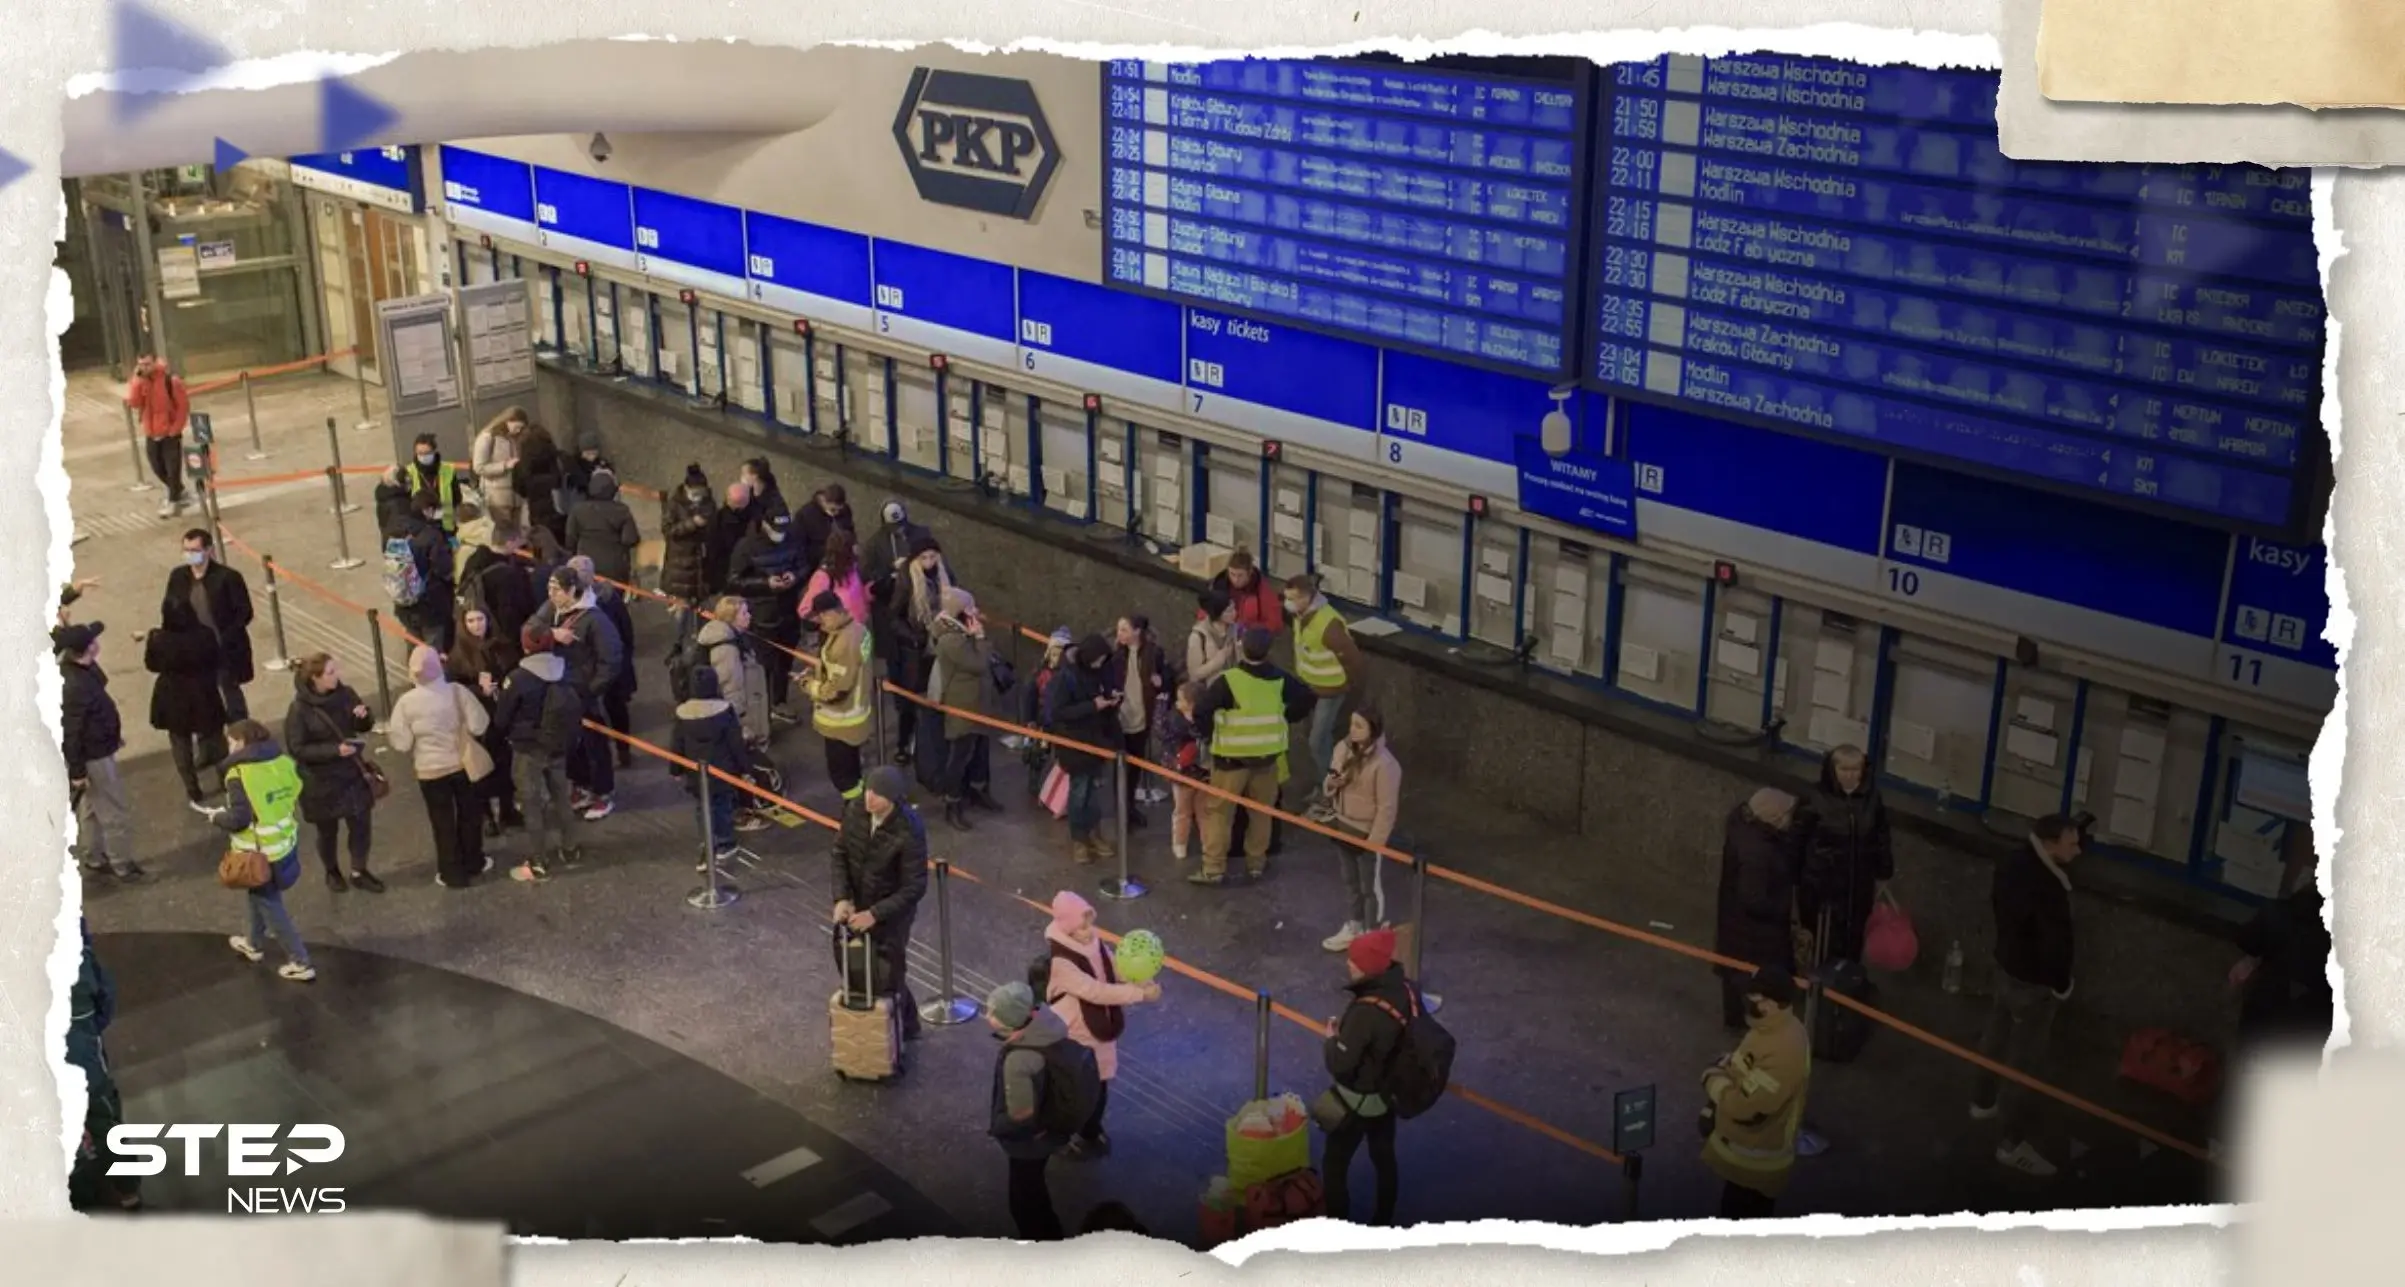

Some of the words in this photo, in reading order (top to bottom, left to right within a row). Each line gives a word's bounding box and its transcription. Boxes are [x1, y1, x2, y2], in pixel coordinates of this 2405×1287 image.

[1616, 67, 1660, 88] 21:45
[1707, 76, 1778, 101] Warszawa
[1784, 62, 1866, 88] Wschodnia
[1615, 96, 1658, 118] 21:50
[1705, 106, 1775, 133] Warszawa
[1779, 115, 1861, 143] Wschodnia
[917, 109, 1035, 176] PKP
[1614, 116, 1656, 139] 21:59
[1703, 128, 1773, 155] Warszawa
[1777, 136, 1859, 166] Zachodnia
[1610, 167, 1651, 190] 22:11
[1700, 181, 1744, 203] Modlin
[1611, 146, 1654, 169] 22:00
[1702, 159, 1771, 186] Warszawa
[1773, 168, 1856, 198] Wschodnia
[2138, 185, 2148, 201] 4
[2177, 188, 2194, 206] IC
[1607, 217, 1649, 240] 22:16
[1608, 196, 1651, 220] 22:15
[1697, 210, 1766, 238] Warszawa
[1769, 220, 1850, 251] Wschodnia
[2173, 224, 2187, 242] IC
[1604, 264, 1646, 289] 22:30
[1605, 246, 1647, 269] 22:30
[1693, 263, 1761, 290] Warszawa
[1765, 273, 1845, 305] Wschodnia
[754, 284, 763, 300] 4
[2122, 302, 2131, 317] 2
[881, 315, 889, 332] 5
[1190, 311, 1220, 335] kasy
[1227, 318, 1270, 343] tickets
[1601, 313, 1642, 338] 22:55
[1603, 295, 1644, 319] 22:35
[1689, 312, 1757, 341] Warszawa
[1761, 323, 1840, 356] Zachodnia
[1026, 352, 1036, 370] 6
[2155, 341, 2171, 358] IC
[1600, 342, 1641, 366] 23:04
[1686, 361, 1730, 385] Modlin
[2152, 365, 2168, 382] IC
[1194, 396, 1204, 413] 7
[1599, 361, 1639, 386] 23:05
[1684, 380, 1751, 410] Warszawa
[1755, 393, 1832, 428] Zachodnia
[2147, 399, 2162, 417] IC
[1389, 442, 1402, 463] 8
[1550, 459, 1598, 482] WITAMY
[2248, 537, 2310, 576] kasy
[1888, 566, 1919, 596] 10
[2229, 654, 2263, 686] 11
